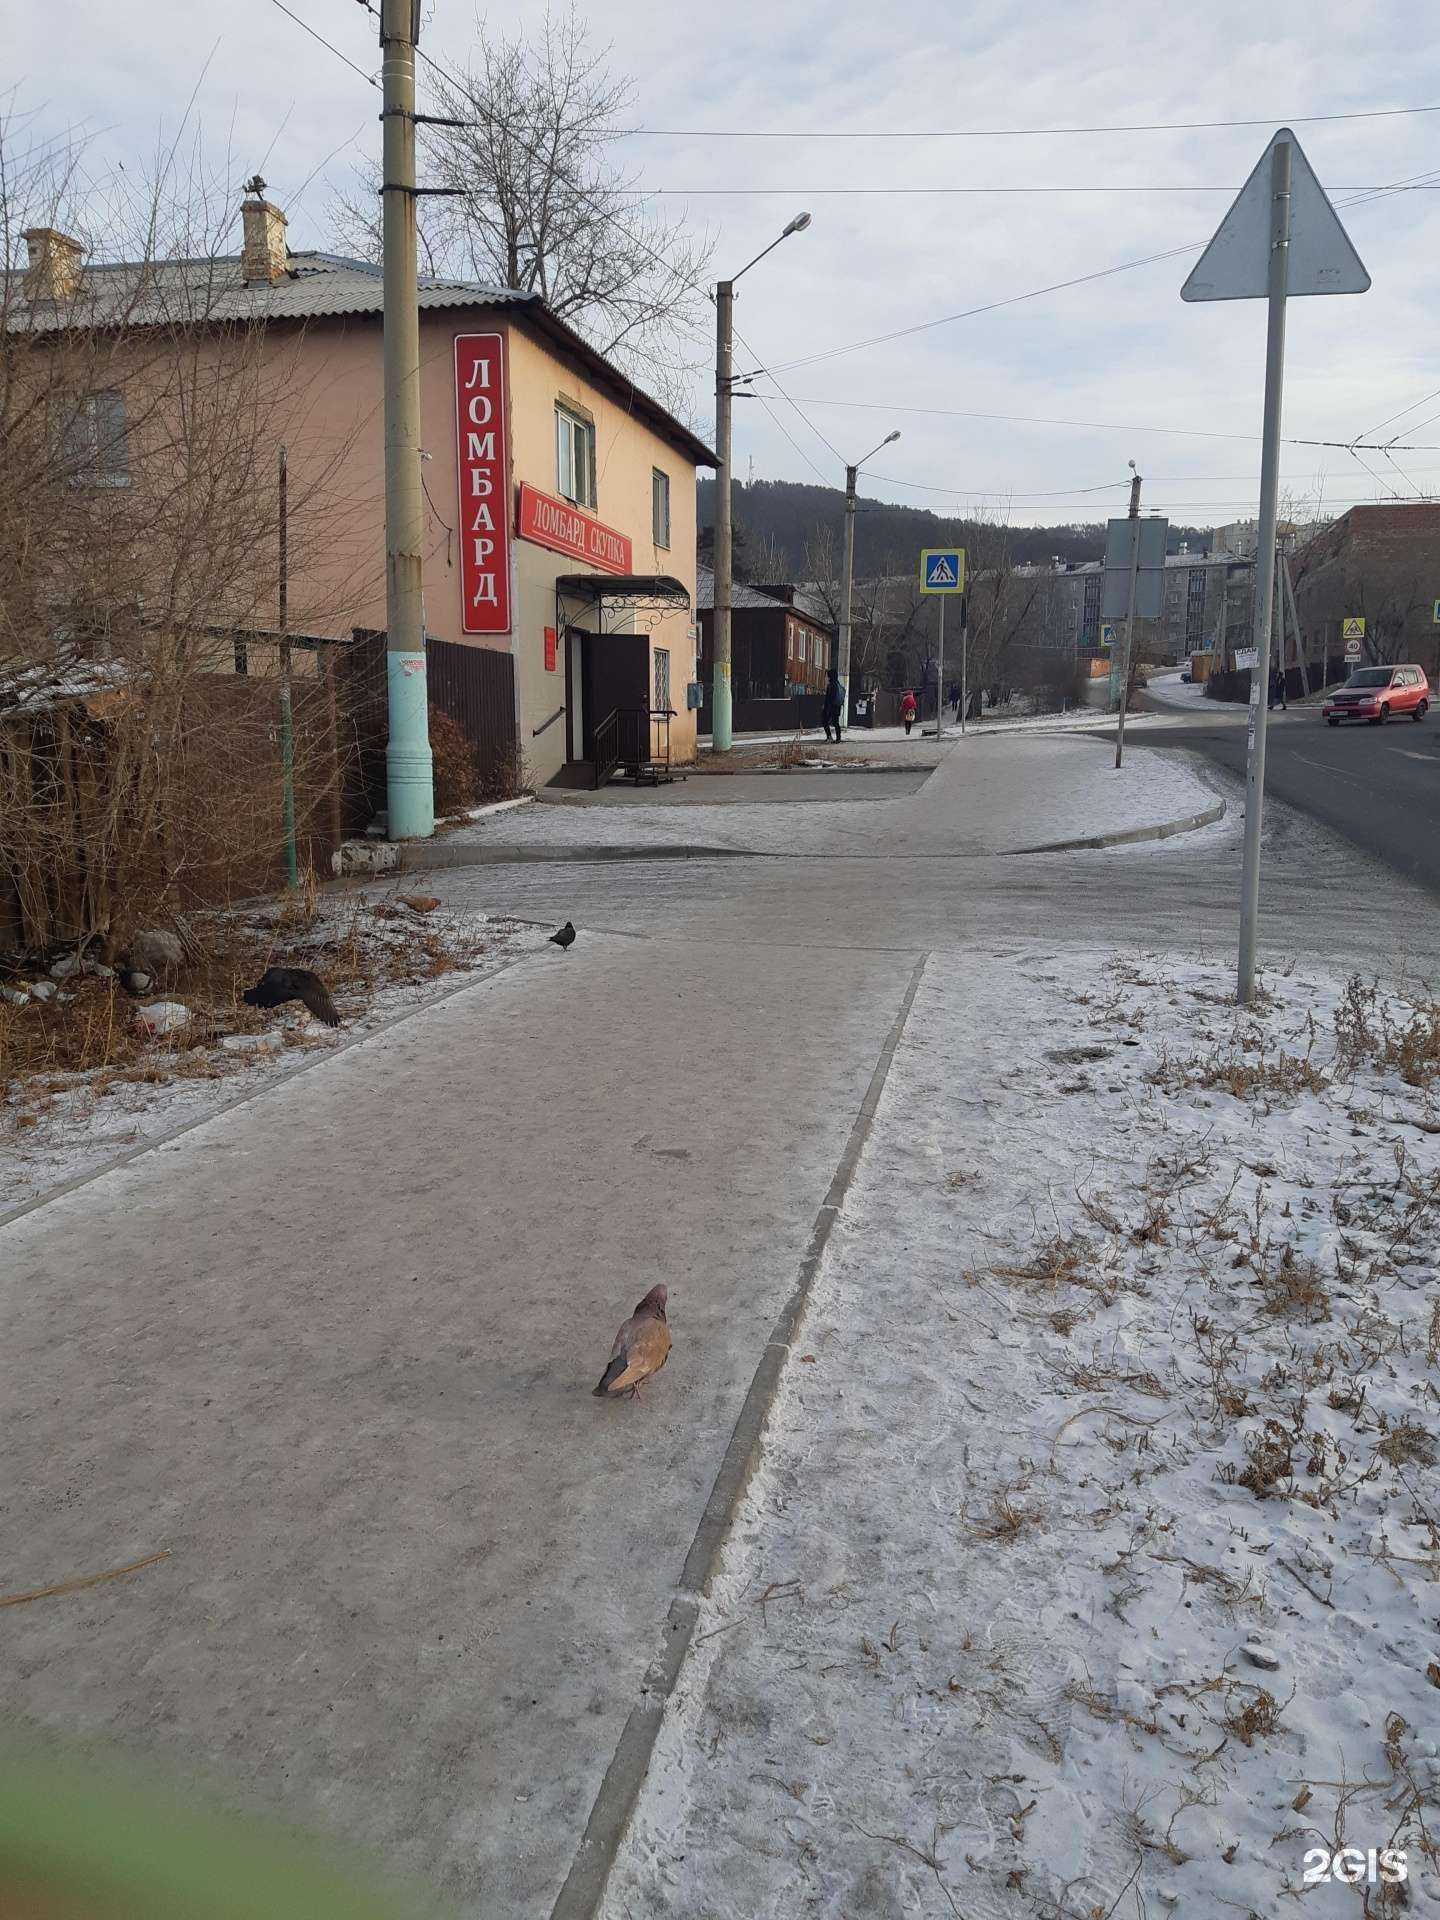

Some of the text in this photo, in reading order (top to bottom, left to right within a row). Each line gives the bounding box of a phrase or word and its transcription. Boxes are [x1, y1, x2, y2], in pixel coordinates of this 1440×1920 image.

[465, 359, 498, 607] ЛОМБАРД
[532, 499, 625, 565] ЛОМБАРД СКУПКА
